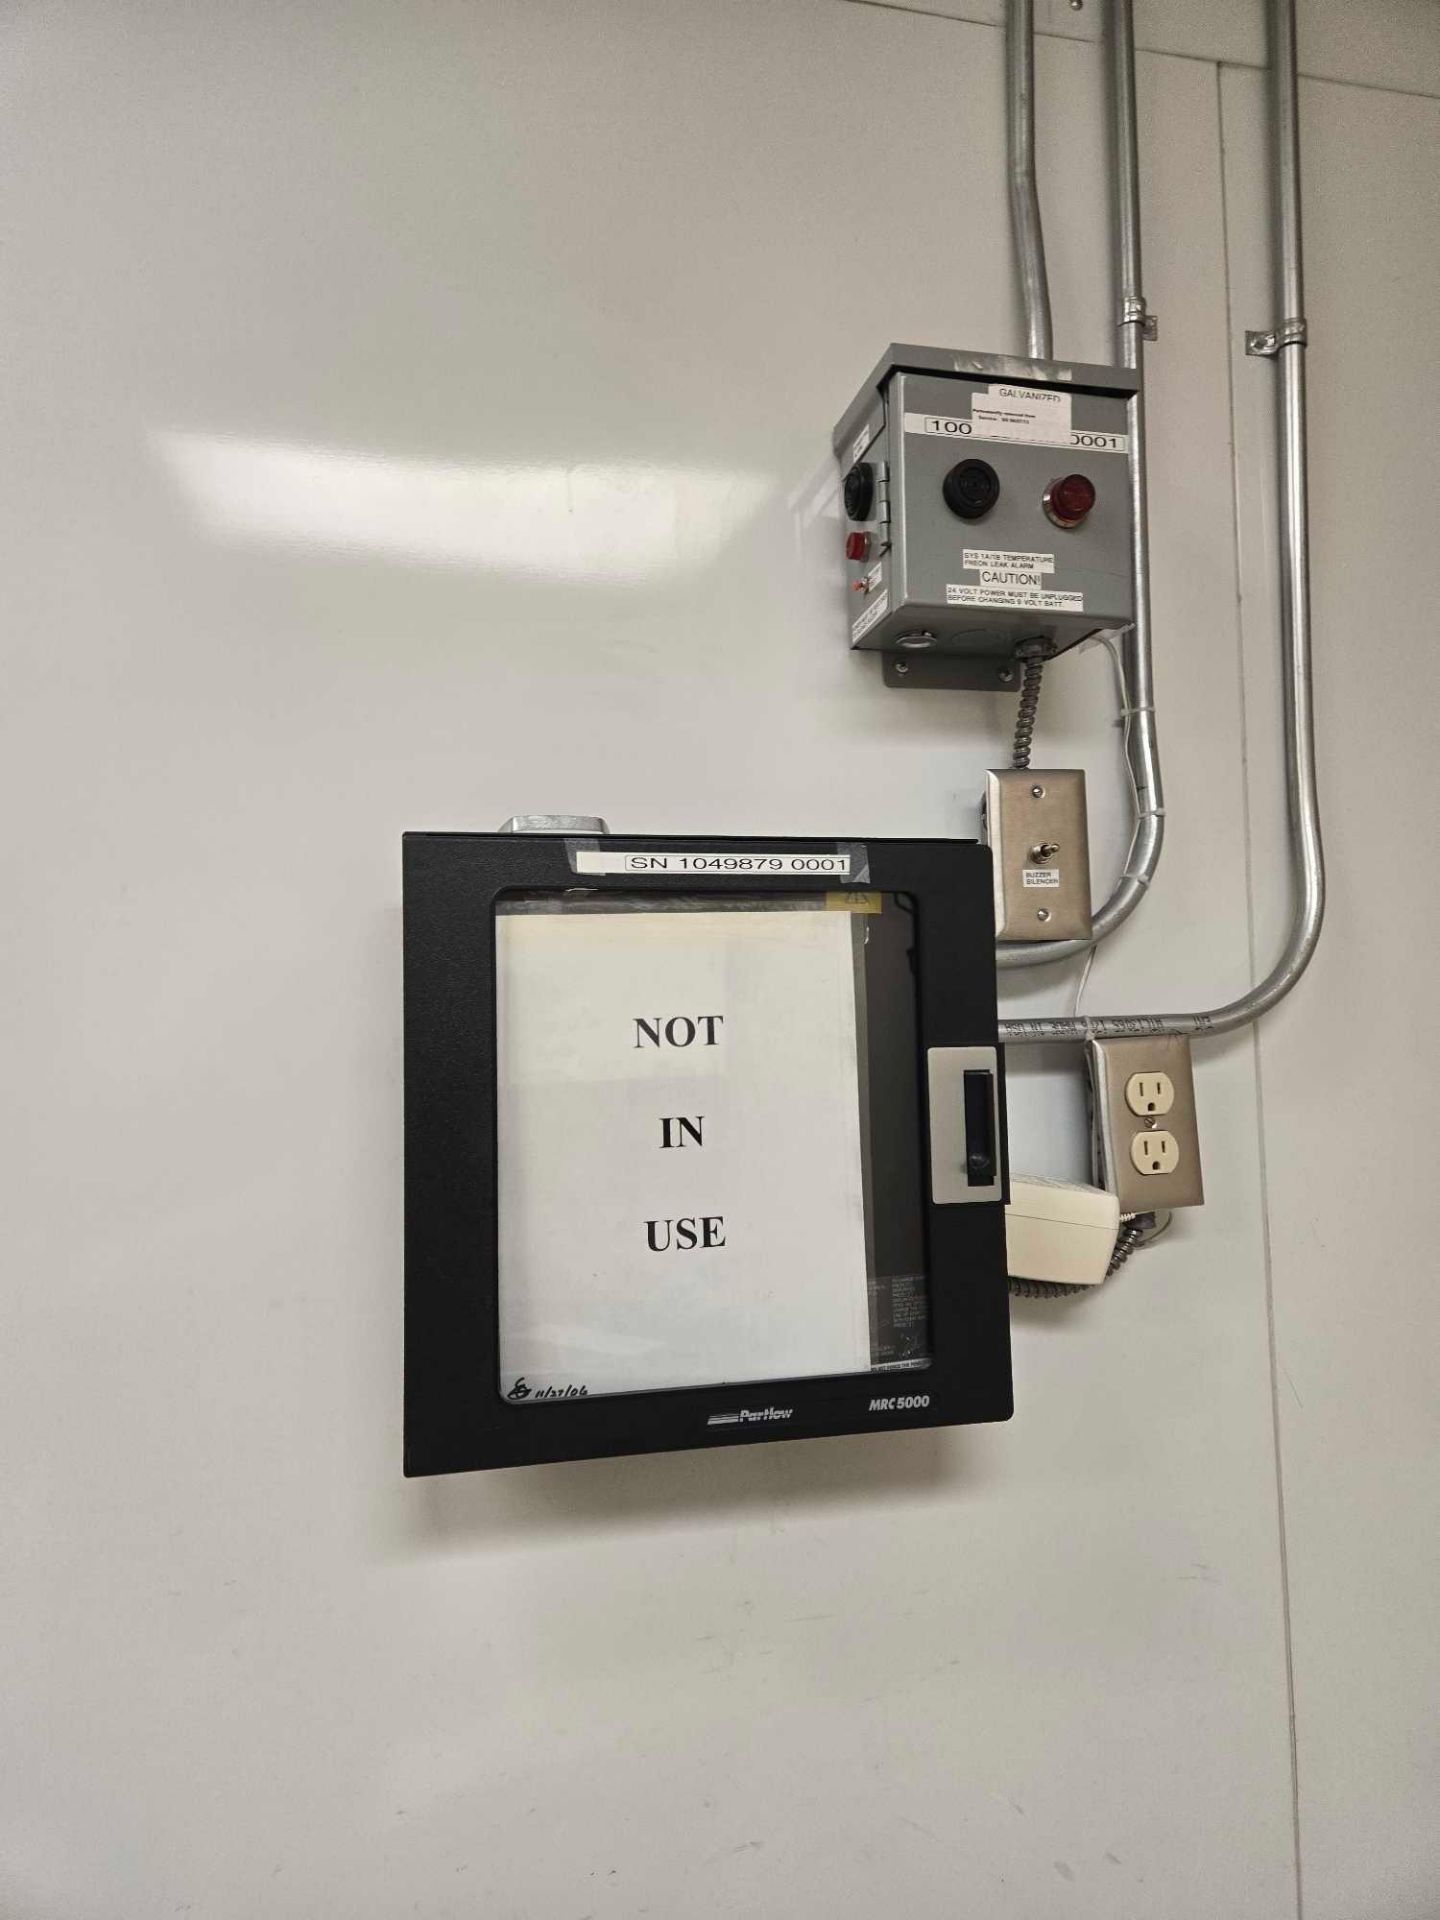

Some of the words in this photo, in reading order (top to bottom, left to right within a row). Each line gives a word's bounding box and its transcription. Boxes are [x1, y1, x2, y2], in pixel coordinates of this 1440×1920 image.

[1003, 554, 1054, 564] TEMPERATURE
[959, 587, 978, 595] VOLT
[980, 589, 1006, 597] POWER
[1041, 593, 1083, 602] UNPLUGGED
[979, 597, 1015, 605] CHANGING
[1024, 599, 1043, 607] VOLT
[630, 857, 668, 870] SN
[680, 857, 783, 871] 1049879
[791, 859, 846, 871] 0001
[633, 1015, 724, 1049] NOT
[659, 1116, 705, 1148] IN
[643, 1216, 726, 1251] USE
[869, 1399, 896, 1411] MRC
[896, 1395, 930, 1409] 5000
[740, 1407, 793, 1422] Partlow
